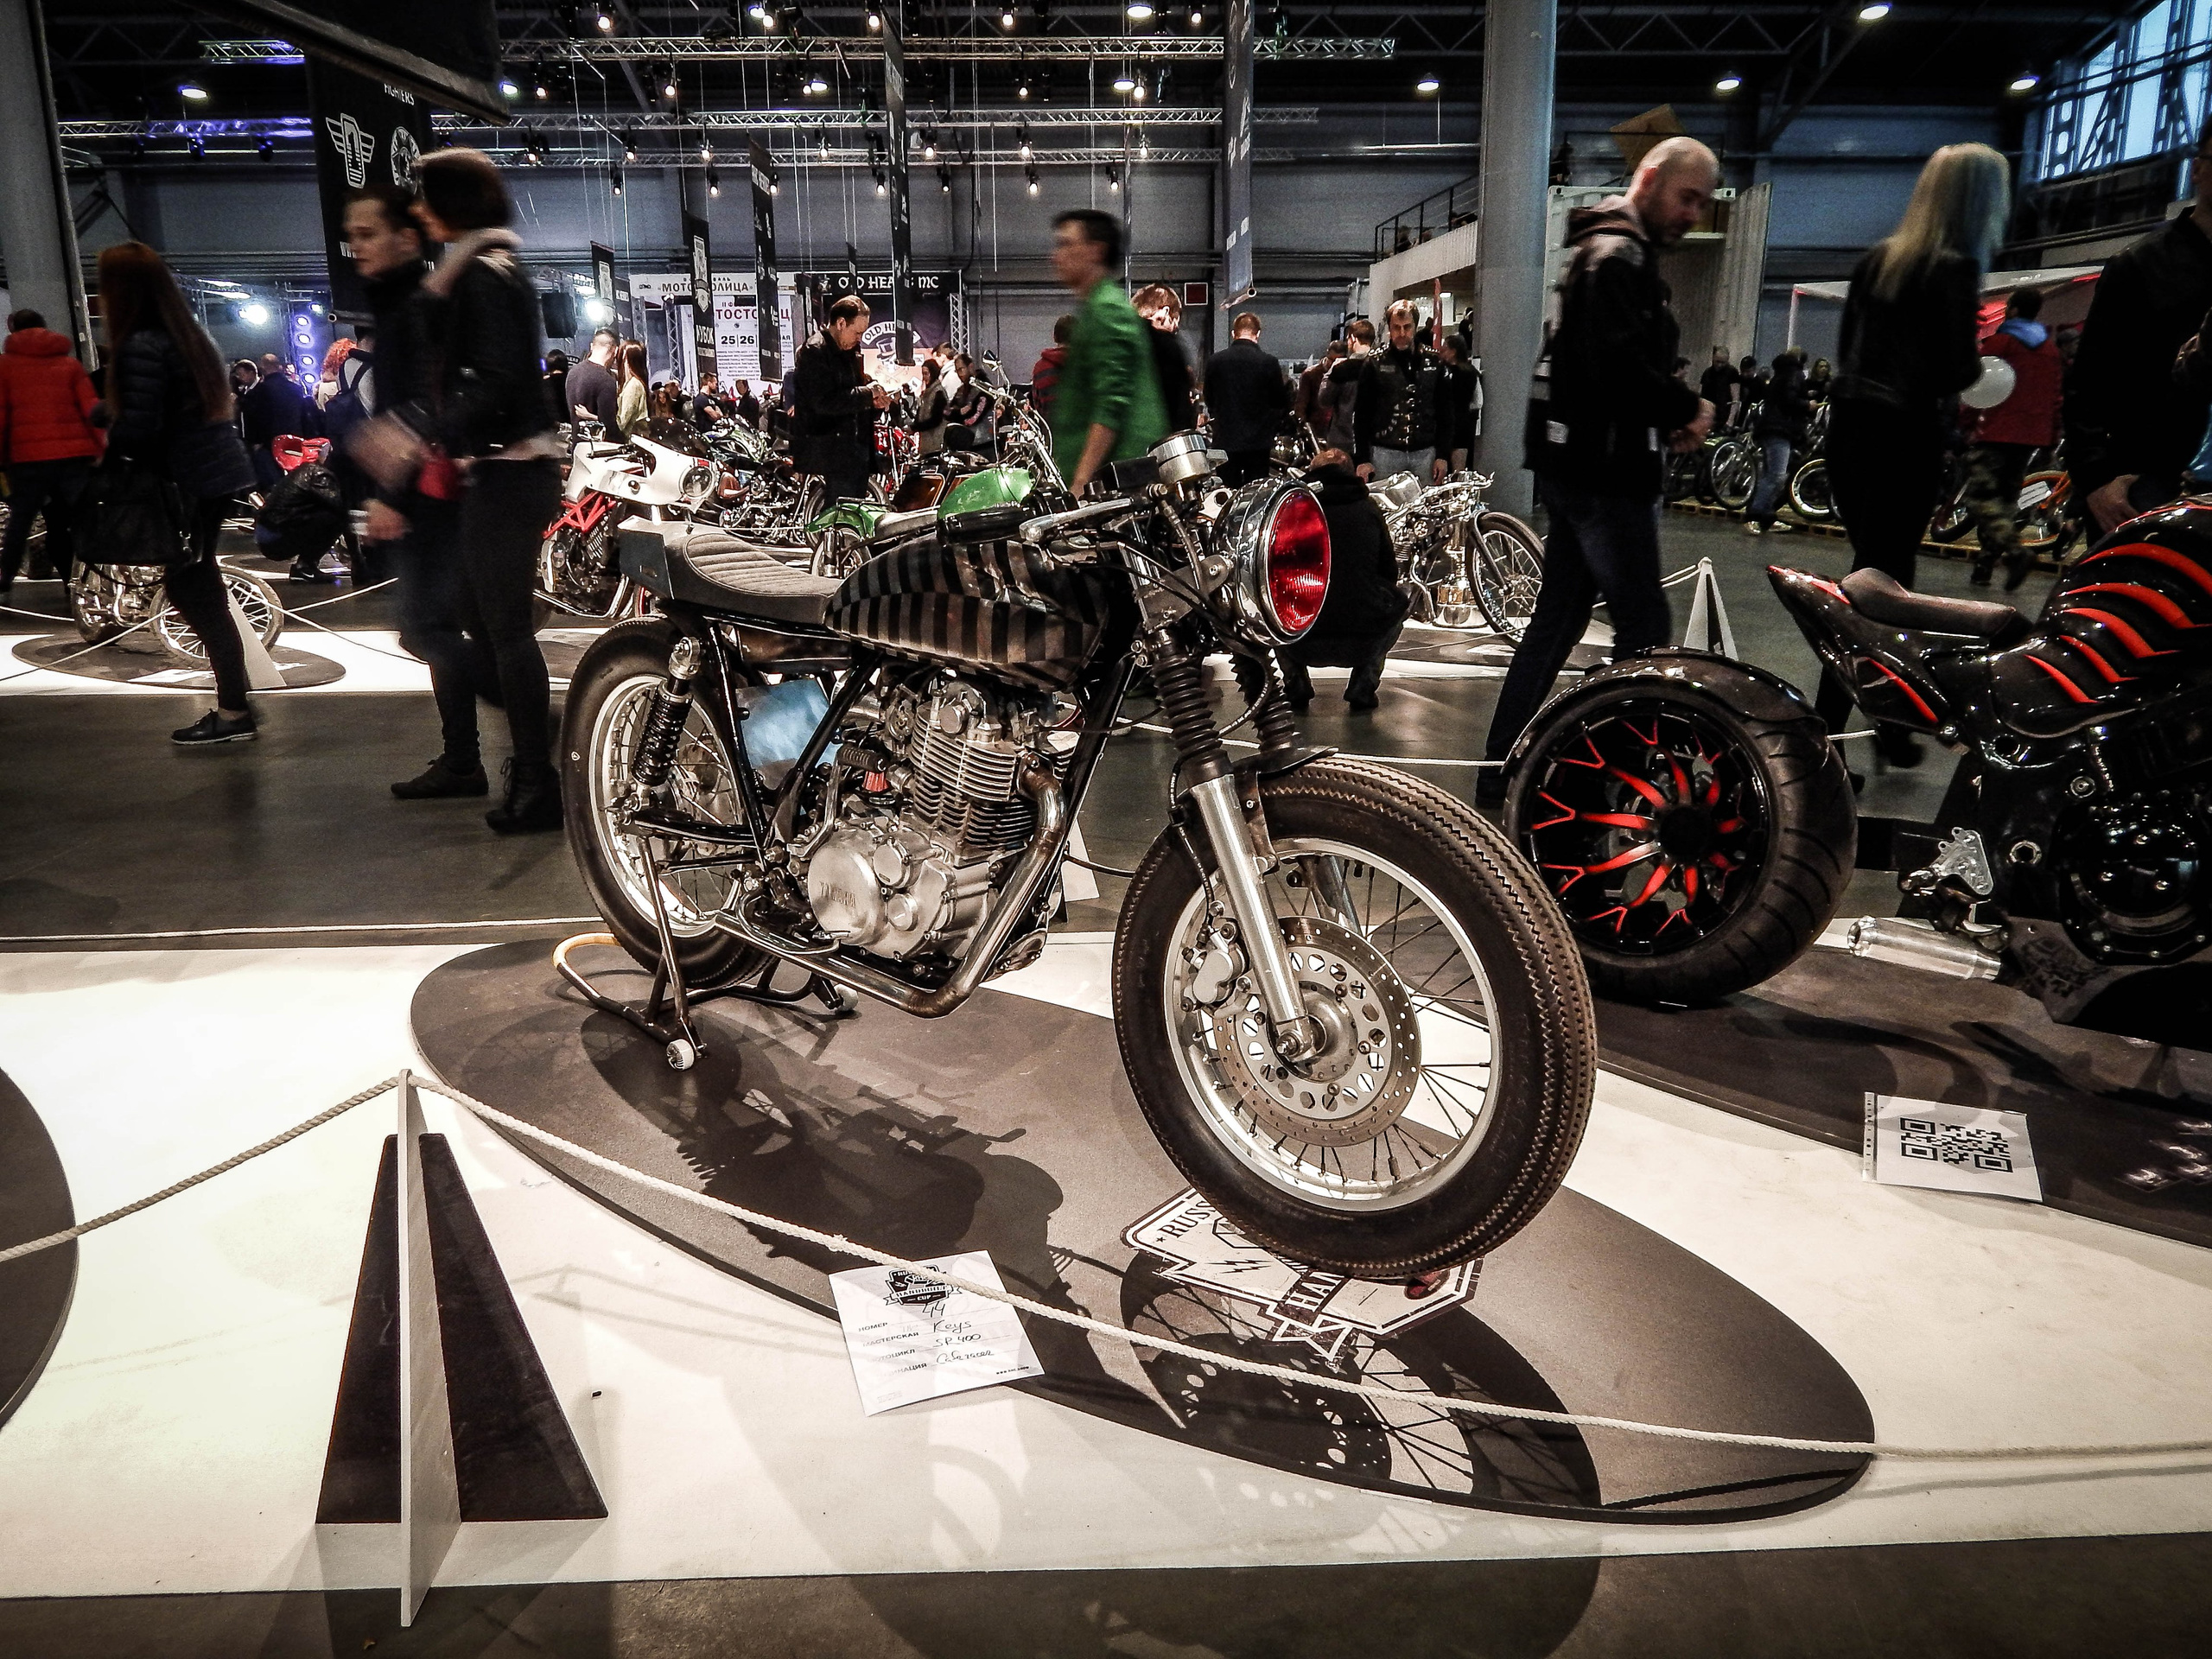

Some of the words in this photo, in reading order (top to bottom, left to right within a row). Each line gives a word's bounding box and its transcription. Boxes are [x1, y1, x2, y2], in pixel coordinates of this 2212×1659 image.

[838, 276, 864, 289] OD
[918, 276, 939, 289] MC
[864, 326, 882, 340] OLD
[721, 335, 735, 345] 25
[740, 335, 754, 345] 26
[1157, 1200, 1217, 1238] RUSS
[922, 1300, 946, 1318] 44
[858, 1322, 888, 1332] НОМЕР
[957, 1333, 982, 1344] 400
[890, 1363, 927, 1376] ИНАЦИЯ
